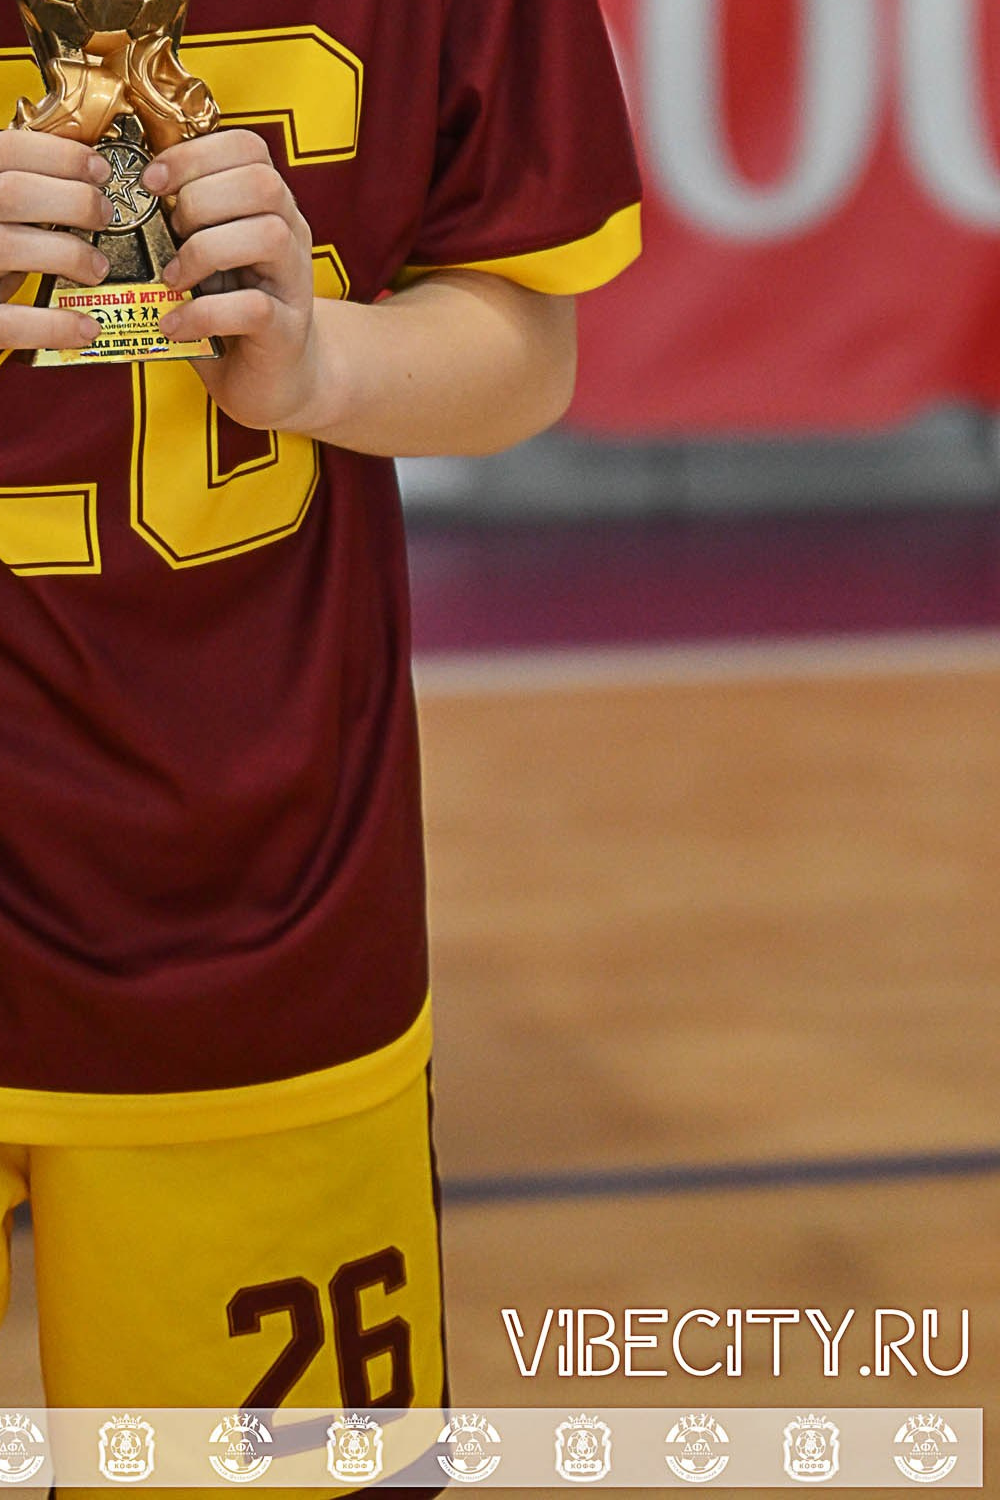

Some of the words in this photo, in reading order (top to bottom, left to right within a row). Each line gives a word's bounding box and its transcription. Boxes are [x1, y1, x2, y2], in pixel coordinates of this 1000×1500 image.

[58, 291, 136, 308] ПОЛЕЗНЫЙ
[140, 290, 185, 304] ИГРОК
[141, 337, 154, 346] ПО
[226, 1245, 416, 1463] 26
